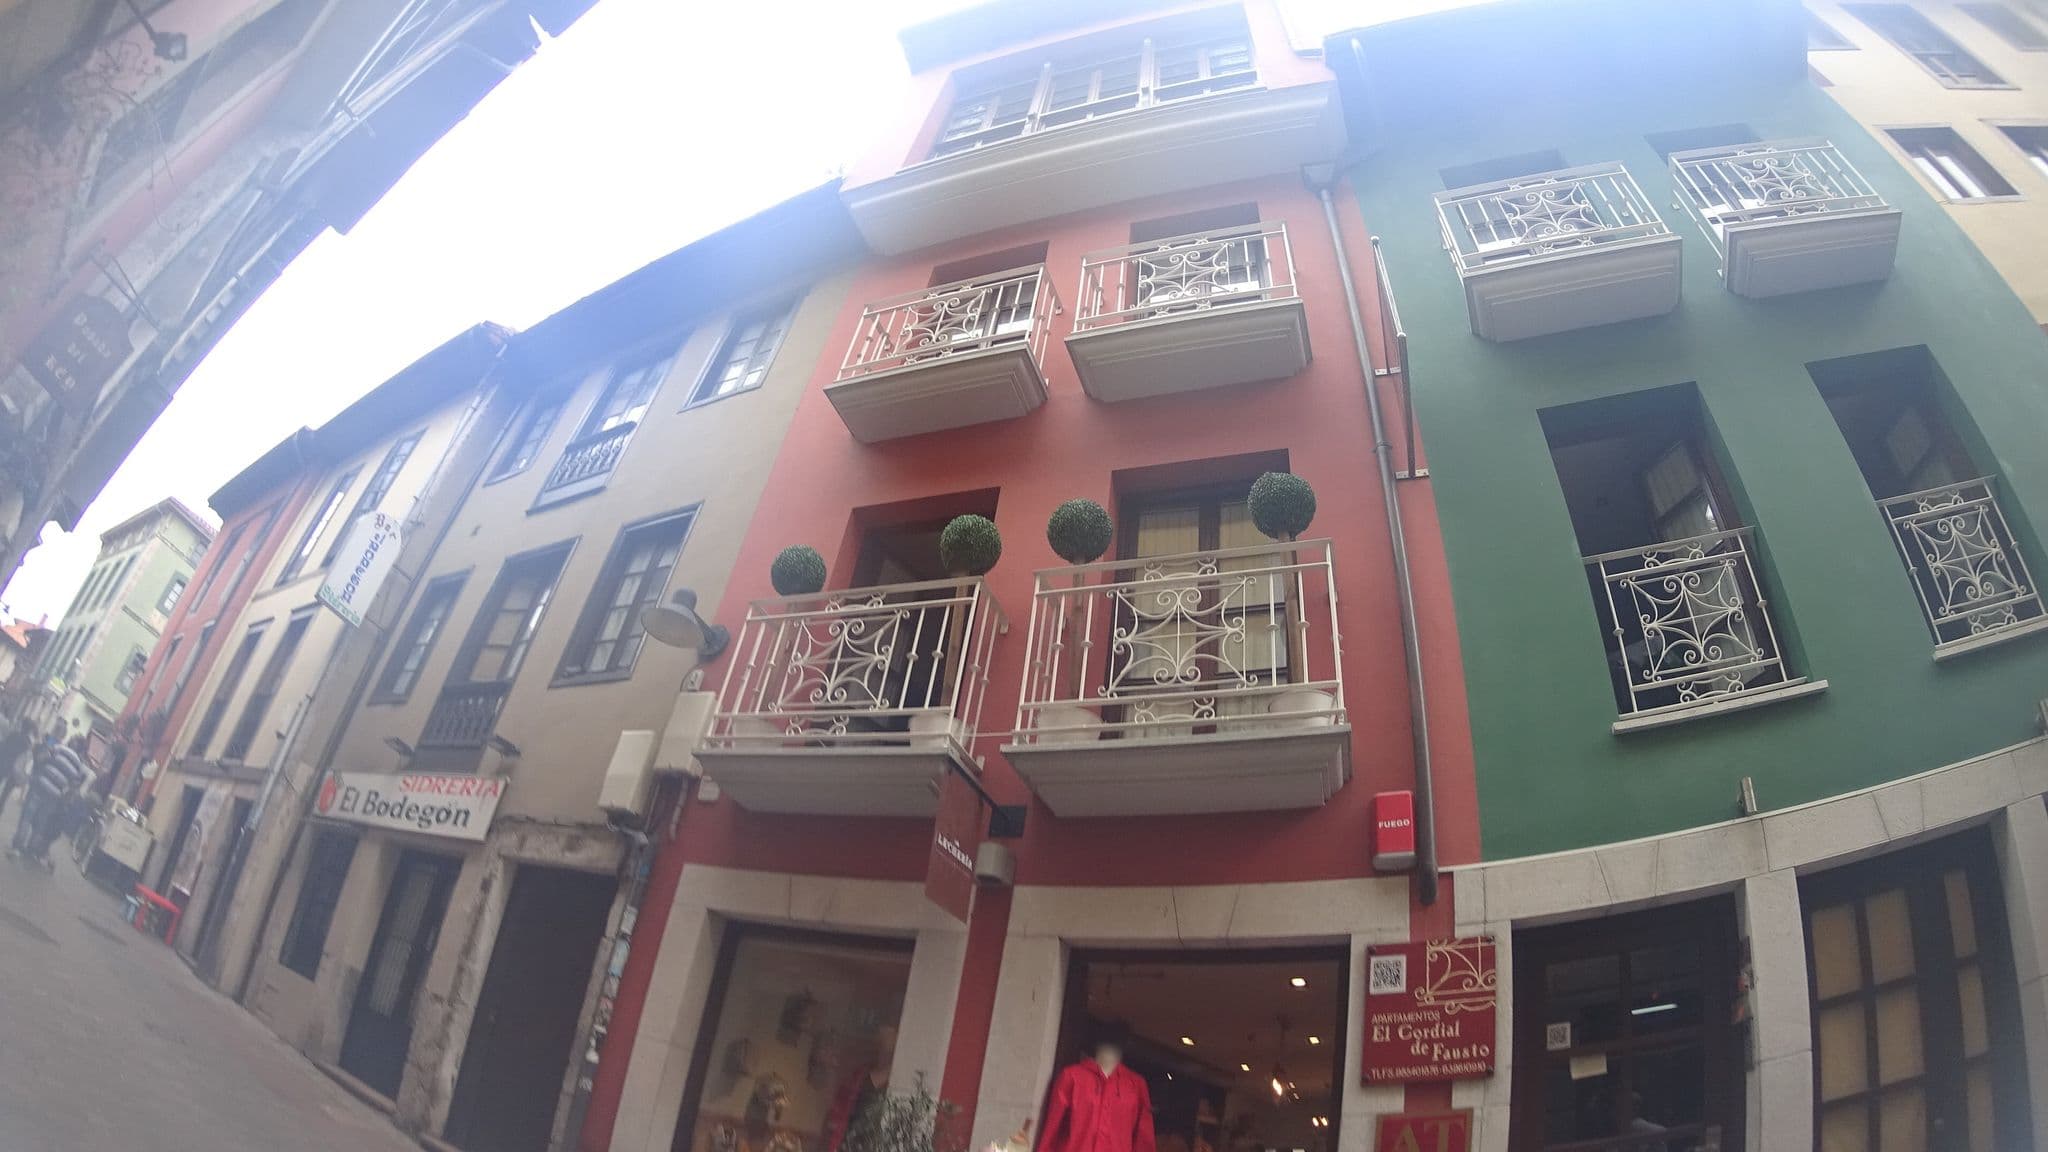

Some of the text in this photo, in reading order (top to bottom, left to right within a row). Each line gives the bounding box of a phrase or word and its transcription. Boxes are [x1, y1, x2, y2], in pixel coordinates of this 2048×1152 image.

[339, 785, 361, 813] El
[1378, 818, 1410, 829] FUEGO
[1371, 1010, 1440, 1025] APARTAMENTOS
[1372, 1020, 1460, 1042] El Cordial
[1410, 1040, 1490, 1061] de Fausto
